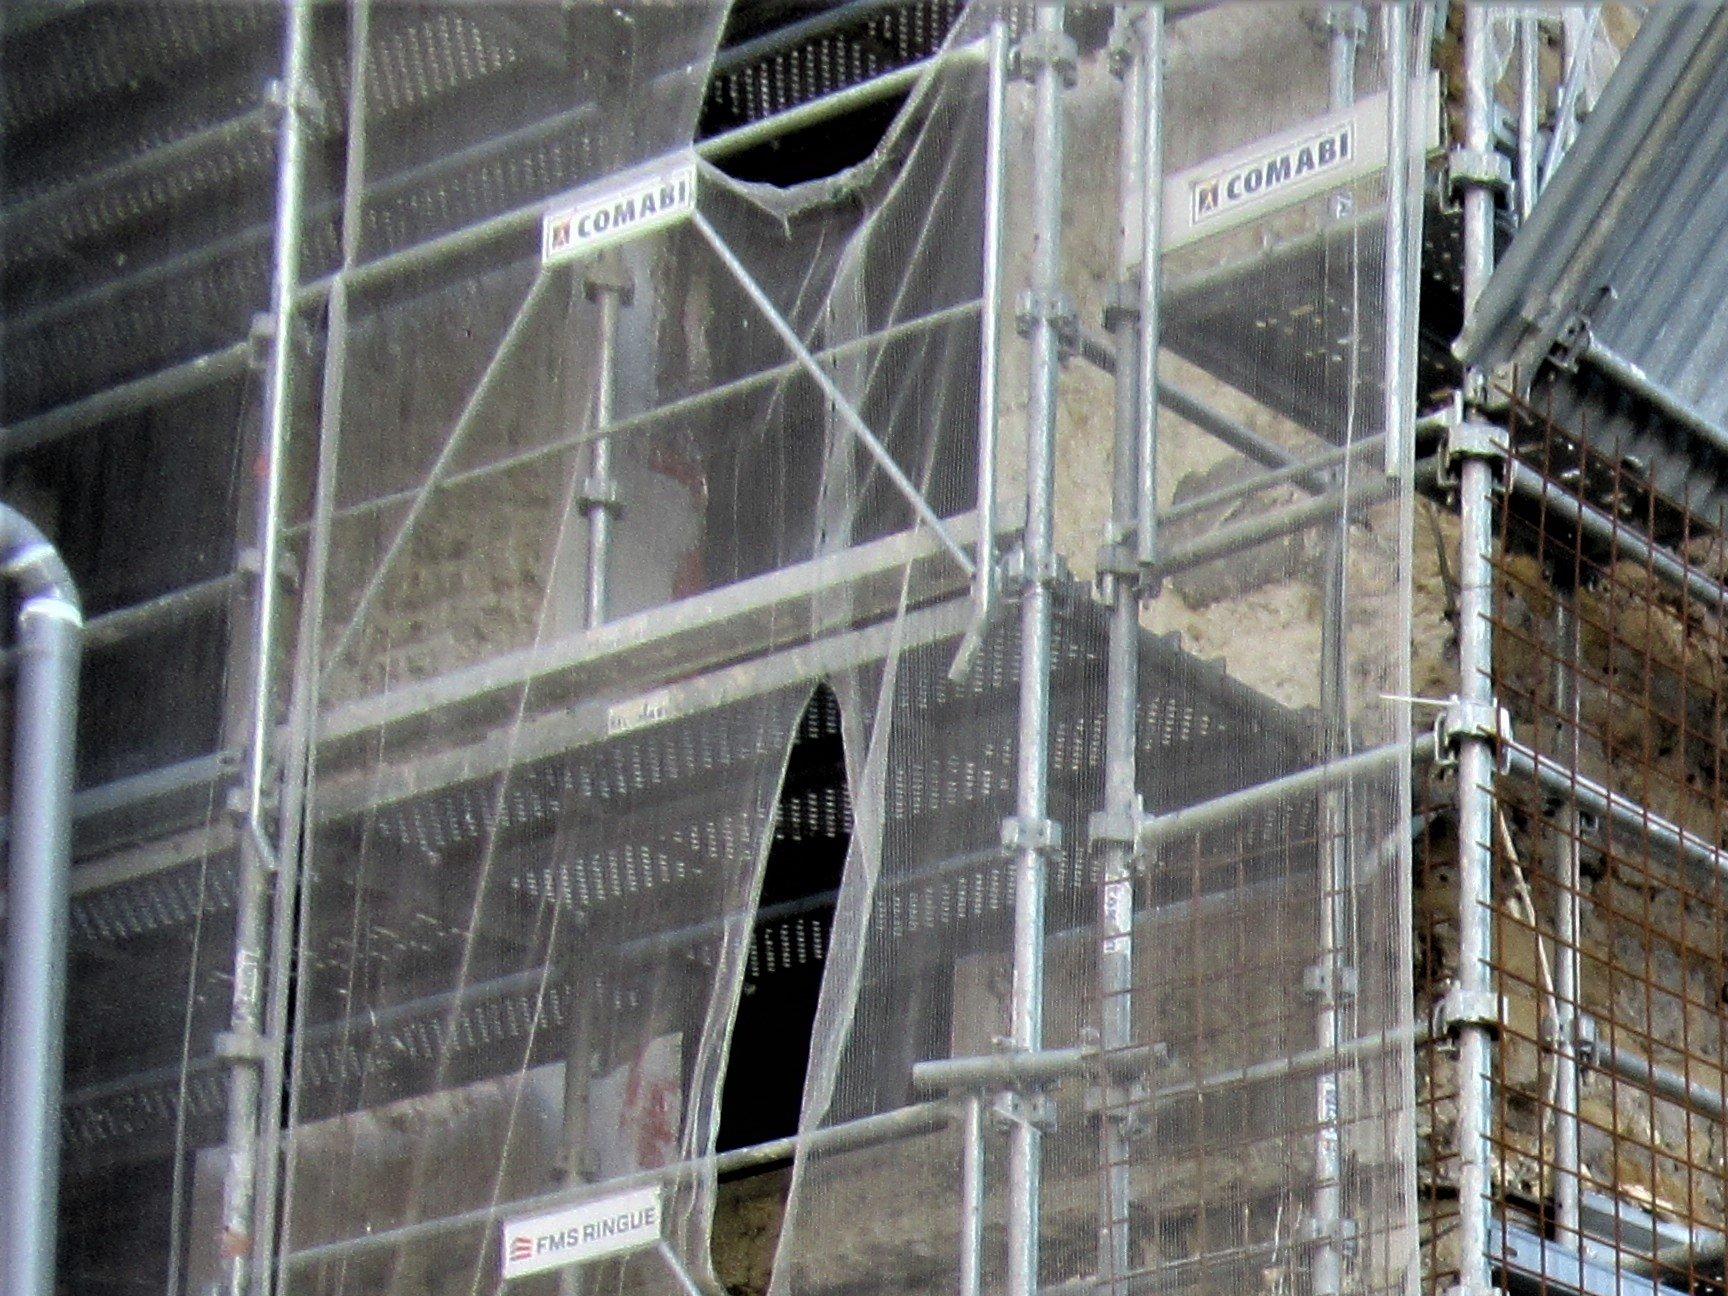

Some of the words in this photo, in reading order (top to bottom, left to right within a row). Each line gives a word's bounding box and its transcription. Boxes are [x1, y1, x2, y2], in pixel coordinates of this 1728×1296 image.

[1226, 131, 1349, 200] COMABI
[577, 180, 688, 238] COMABI
[536, 1227, 579, 1255] FMS
[582, 1207, 656, 1243] RINGUE
